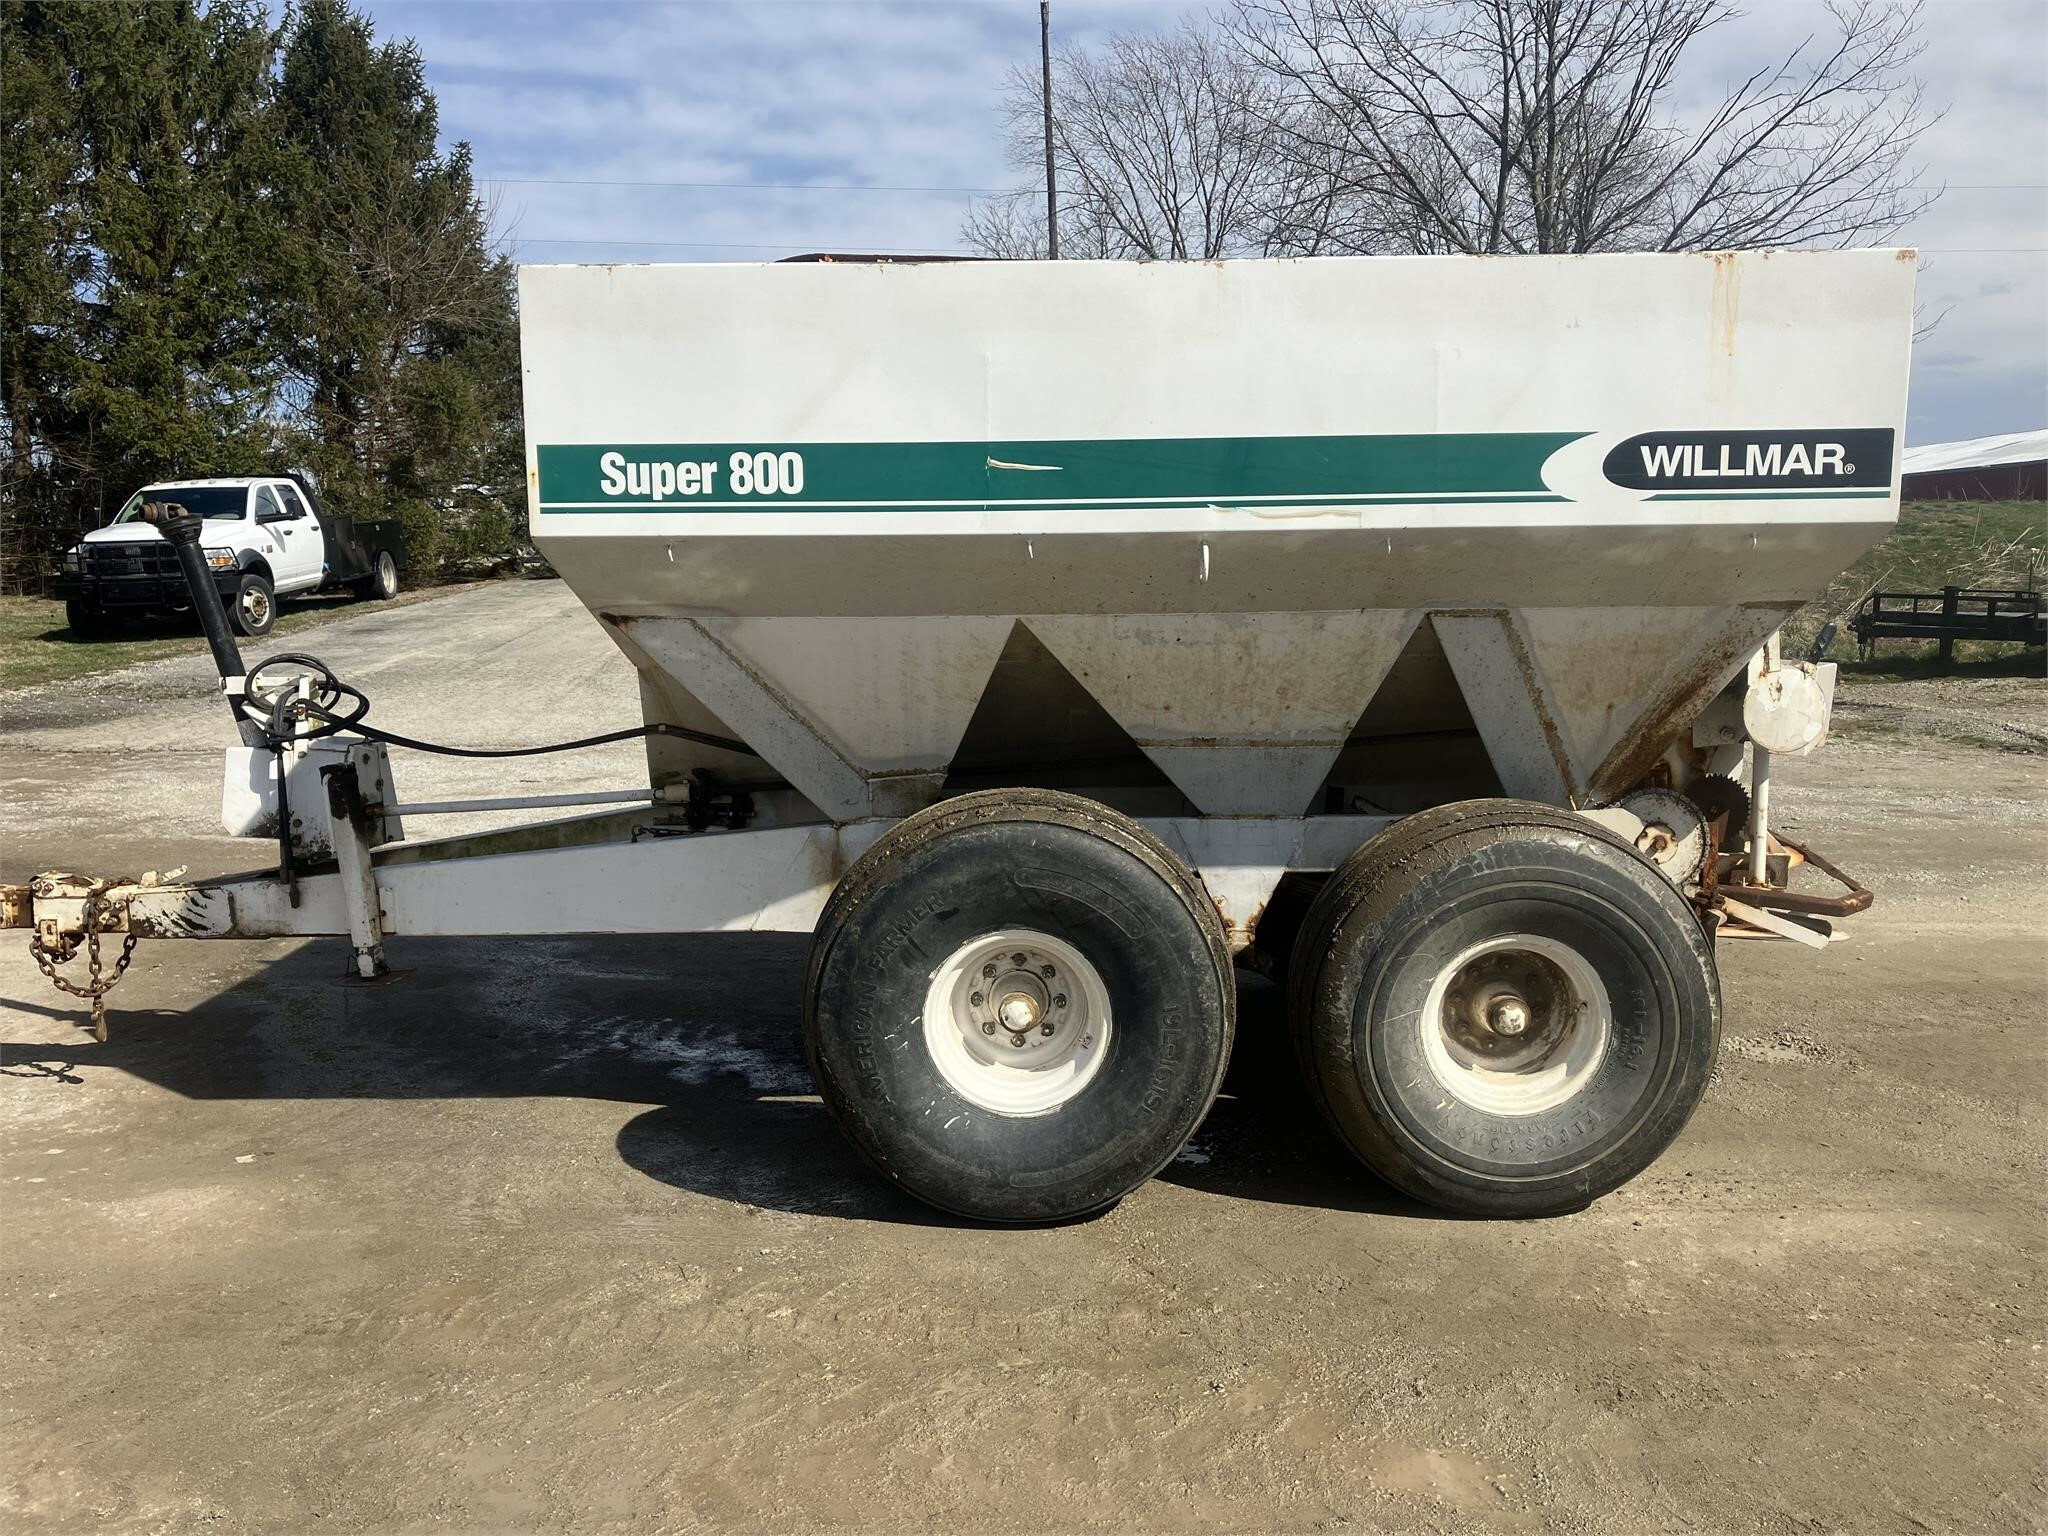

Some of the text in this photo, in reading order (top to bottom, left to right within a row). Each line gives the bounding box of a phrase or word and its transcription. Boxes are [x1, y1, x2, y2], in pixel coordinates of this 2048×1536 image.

[601, 452, 803, 500] Super 800
[872, 891, 945, 970] FARMER
